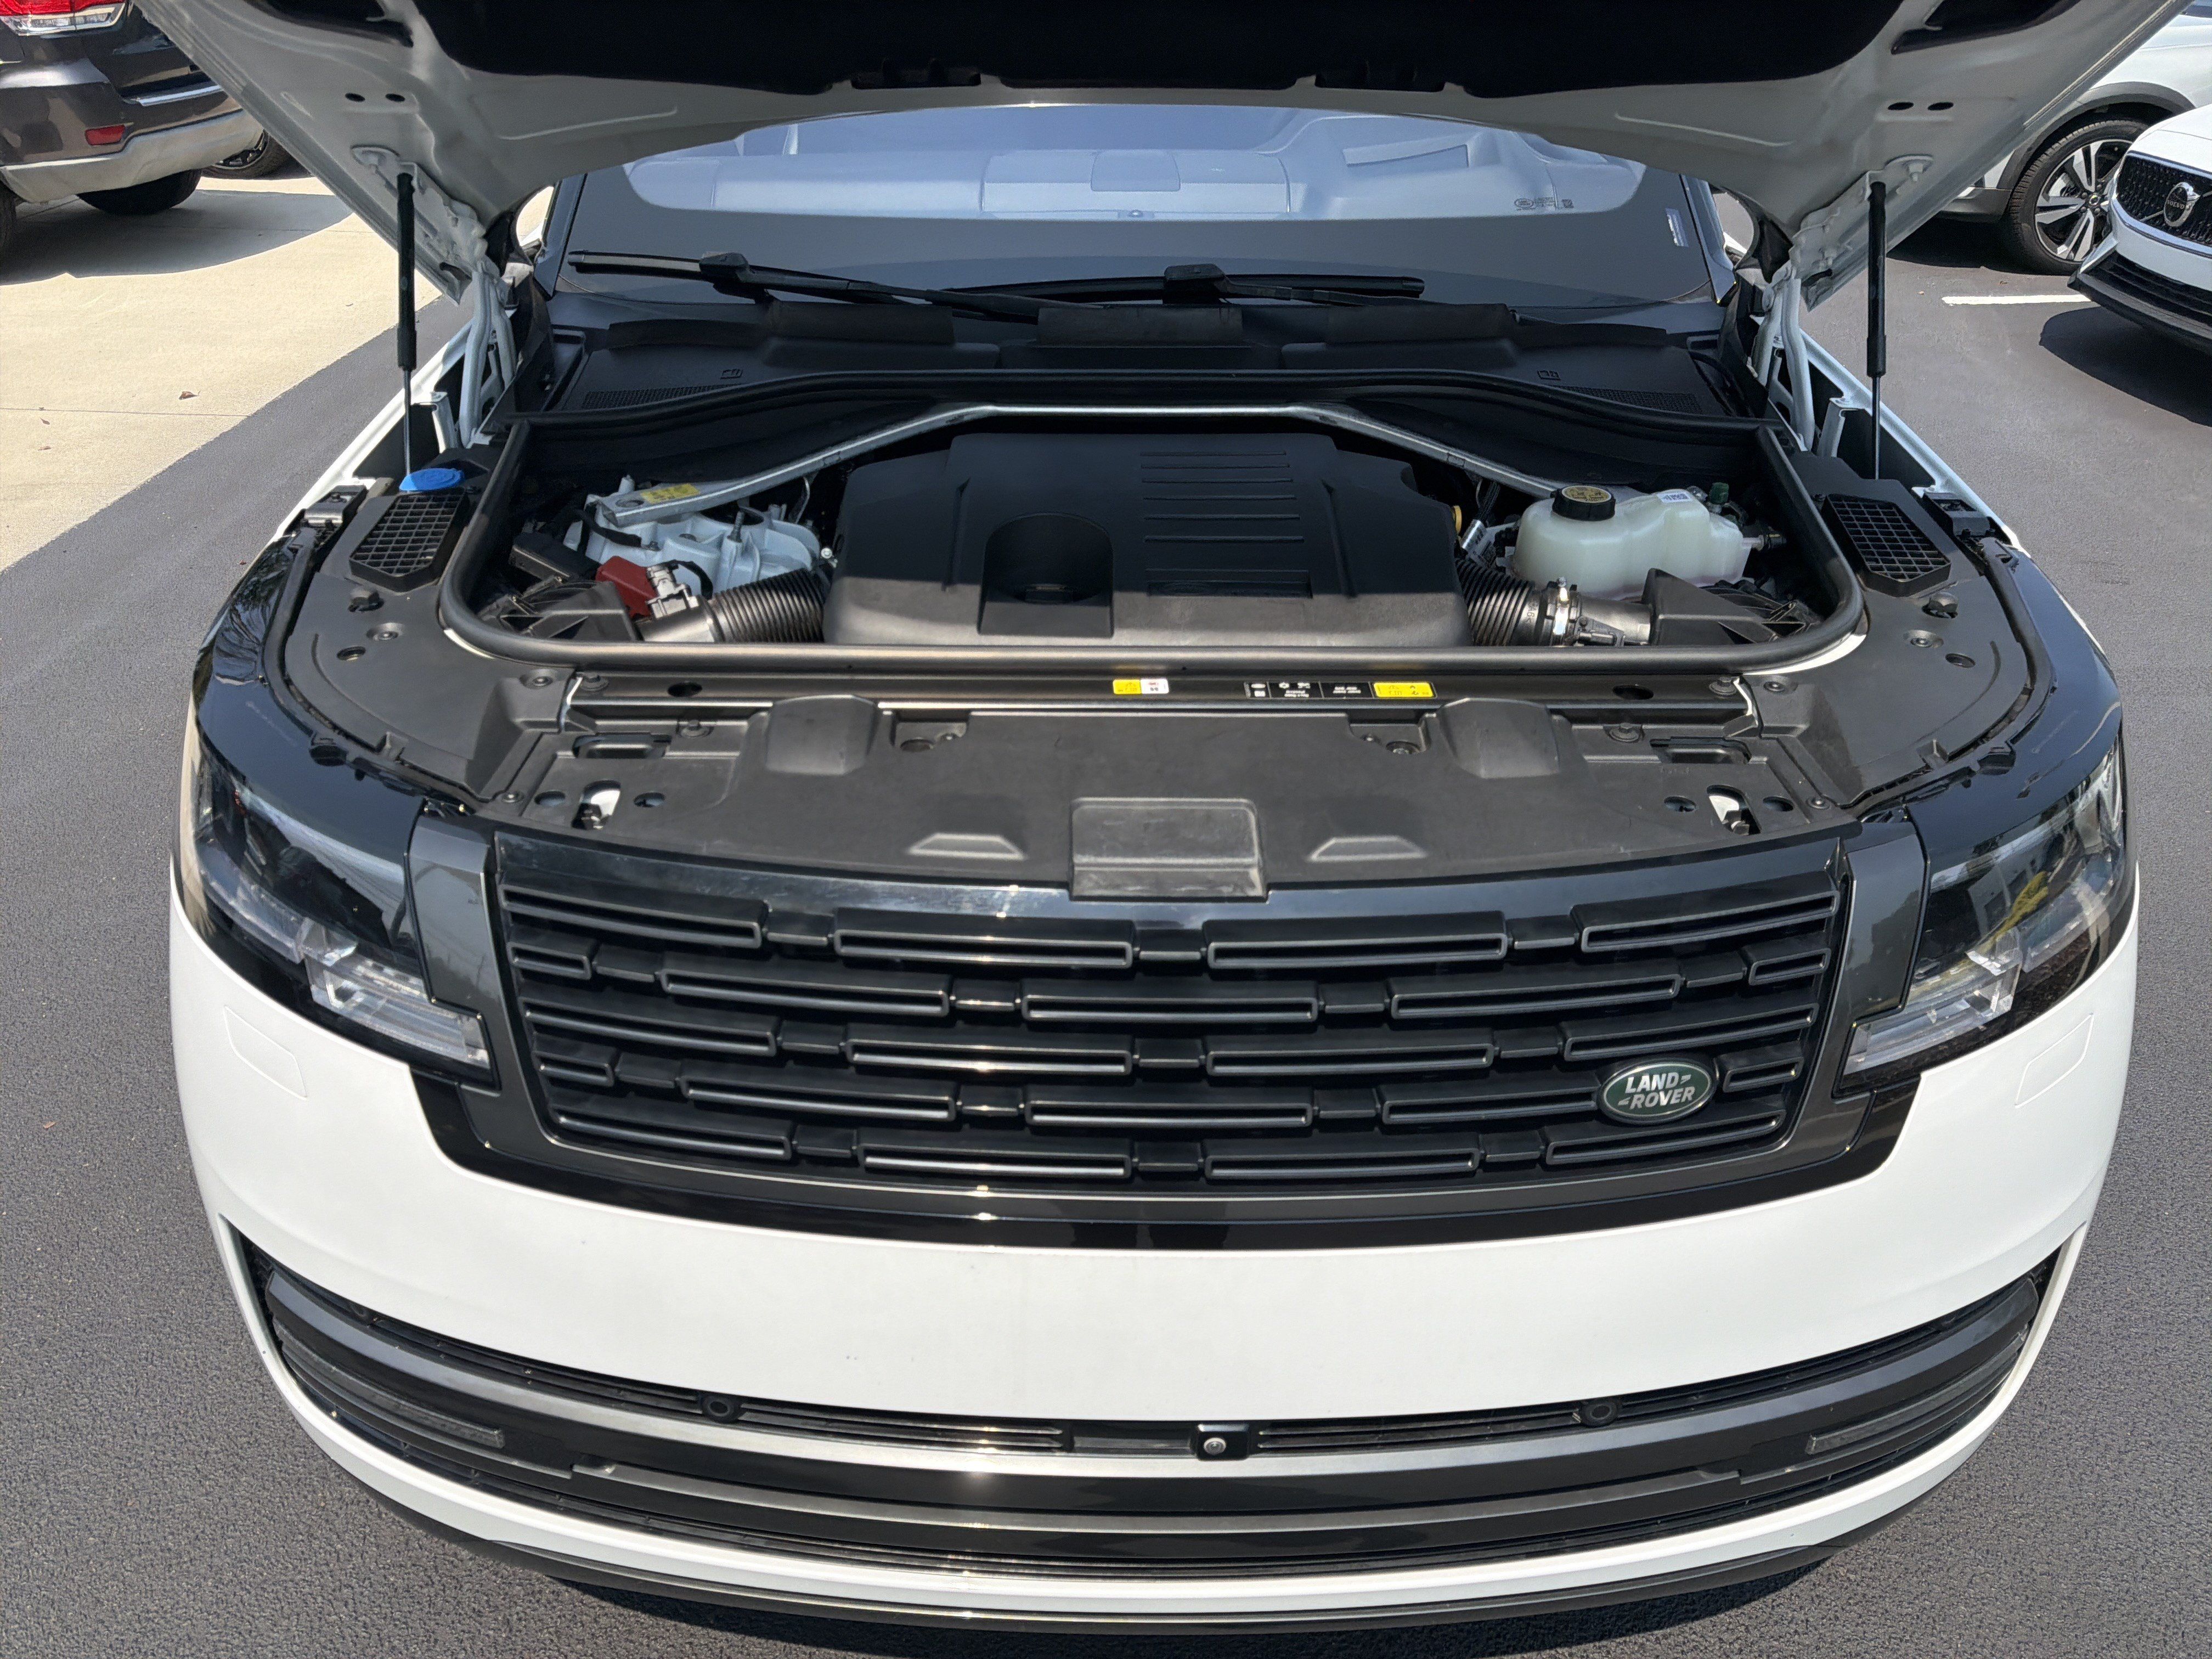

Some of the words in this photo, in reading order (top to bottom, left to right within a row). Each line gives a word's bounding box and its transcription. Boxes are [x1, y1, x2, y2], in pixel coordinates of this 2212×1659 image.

[2167, 200, 2185, 210] VOLVO
[1625, 1072, 1679, 1093] LAND
[1629, 1086, 1695, 1109] ROVER
